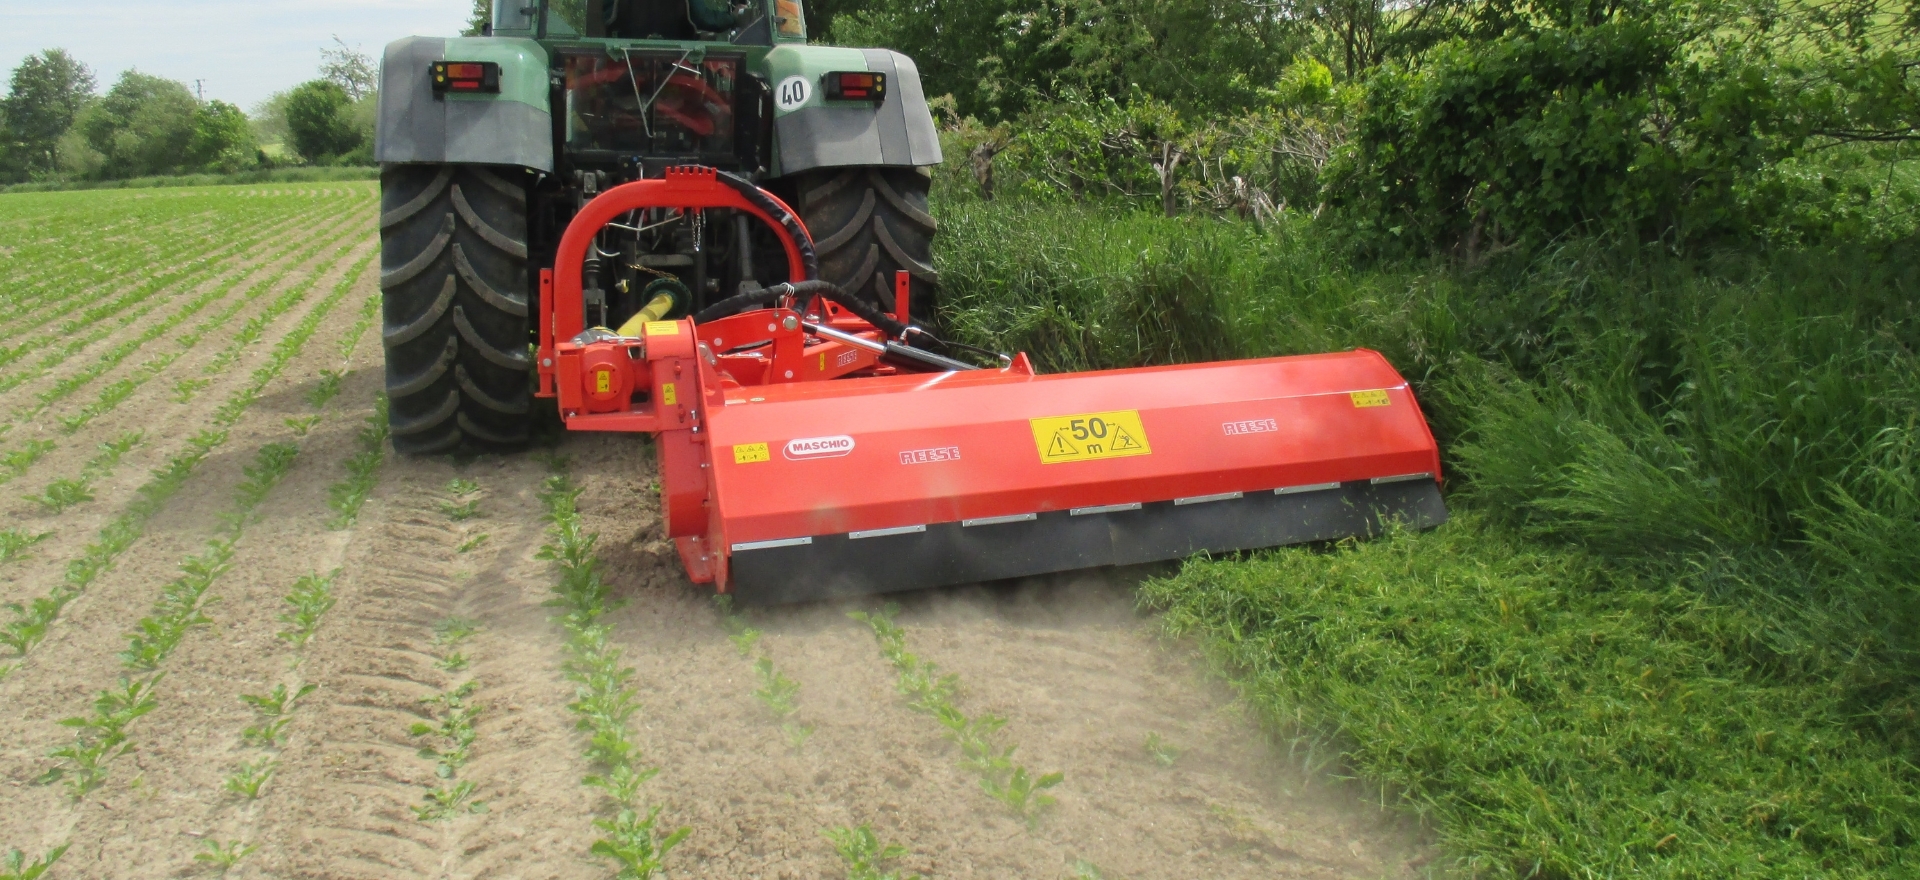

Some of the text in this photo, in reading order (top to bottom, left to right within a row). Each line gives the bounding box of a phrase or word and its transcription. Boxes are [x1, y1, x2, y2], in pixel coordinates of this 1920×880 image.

[782, 80, 804, 105] 40
[1070, 417, 1107, 440] 50
[1222, 418, 1278, 436] REESE
[792, 439, 849, 452] MASCHIO
[1086, 442, 1103, 455] m
[900, 446, 960, 464] REESE
